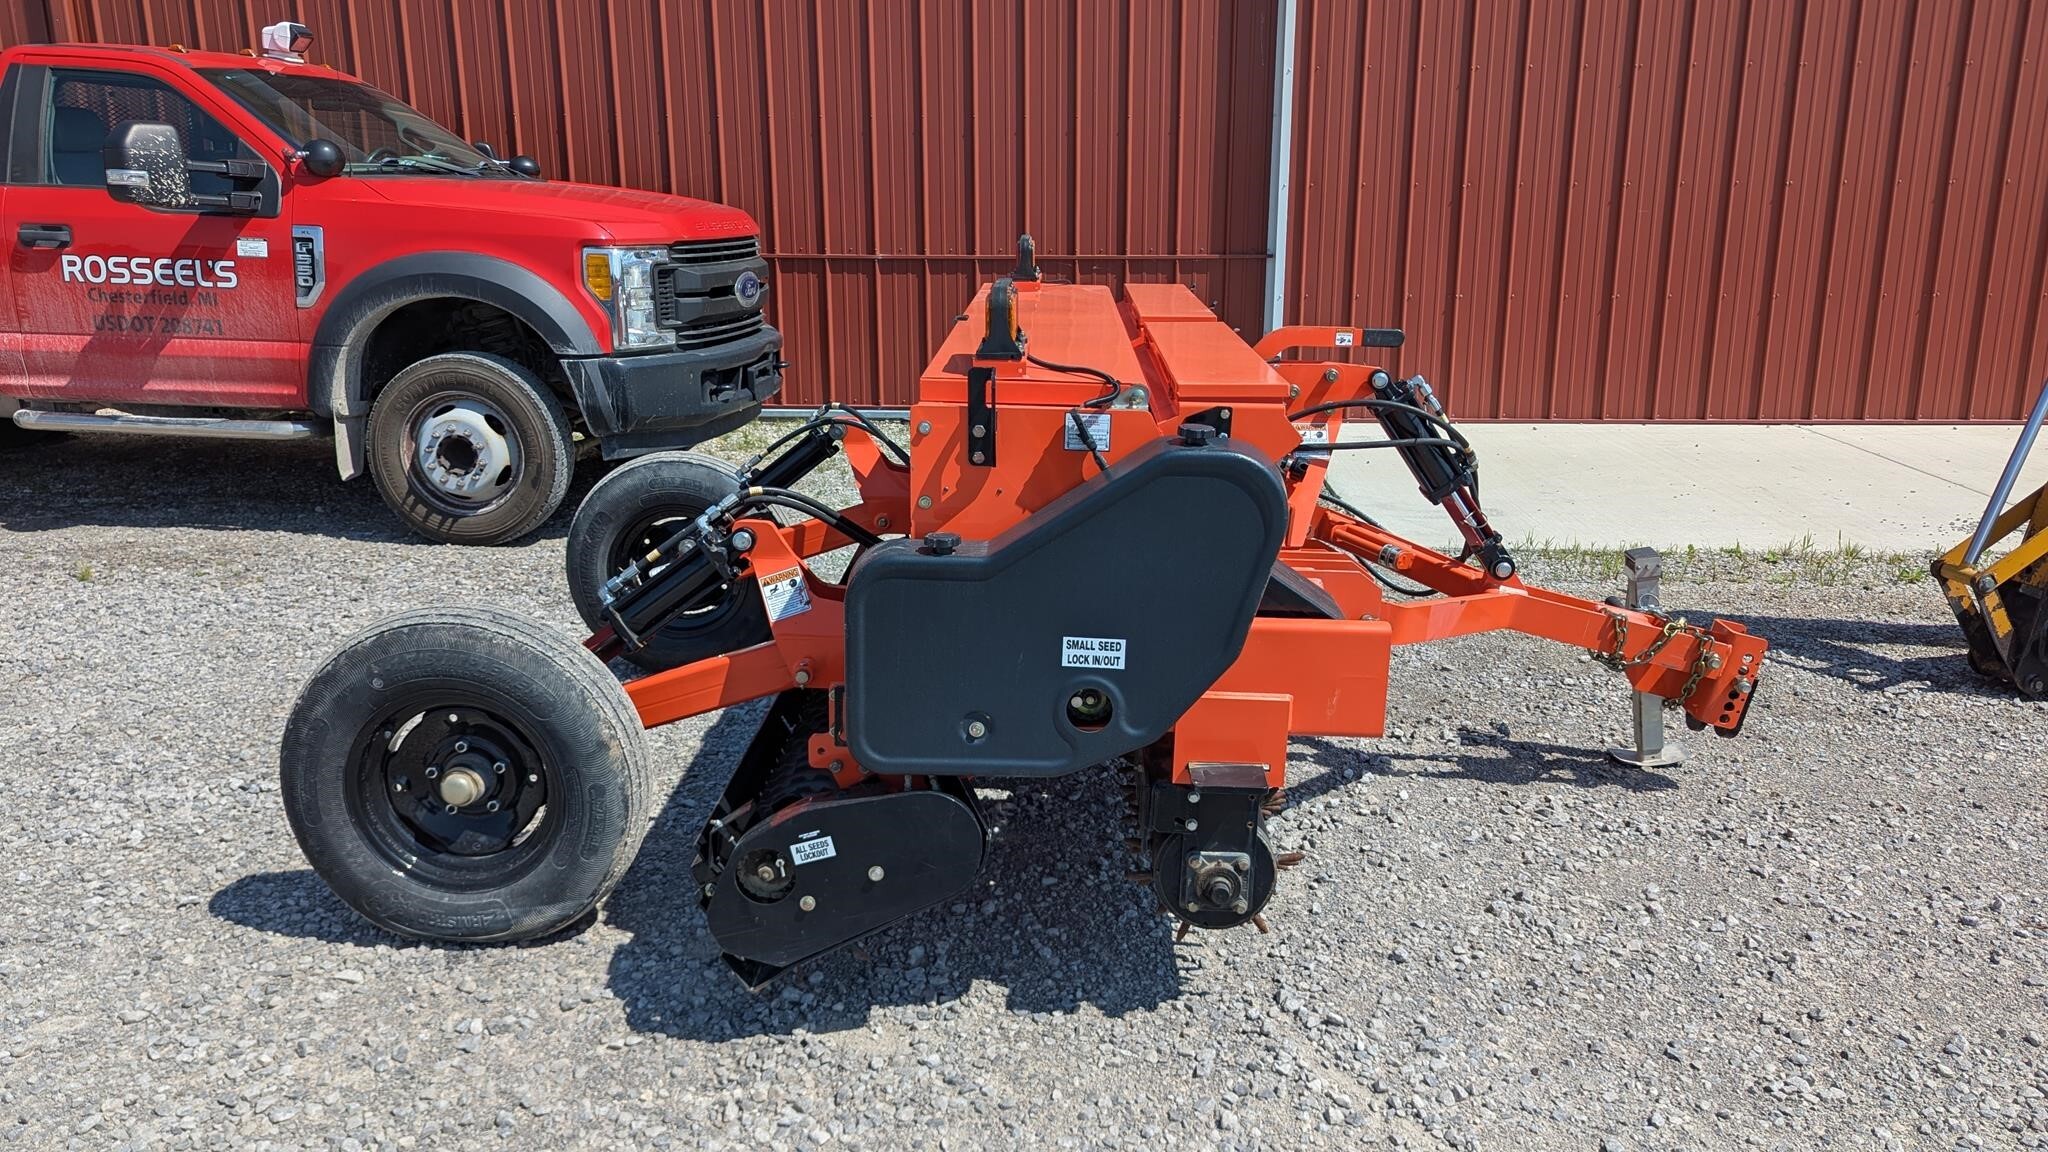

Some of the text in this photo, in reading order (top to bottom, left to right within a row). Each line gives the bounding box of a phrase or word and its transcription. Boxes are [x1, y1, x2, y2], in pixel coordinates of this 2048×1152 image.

[61, 254, 238, 288] ROSSEEL'S
[92, 314, 154, 333] USDOT
[767, 567, 799, 584] WARNING
[1066, 639, 1122, 652] SMALL SEED
[1067, 653, 1121, 667] LOCK IN/OUT
[795, 840, 829, 854] ALL SEEDS
[800, 848, 829, 861] LOCKOUT
